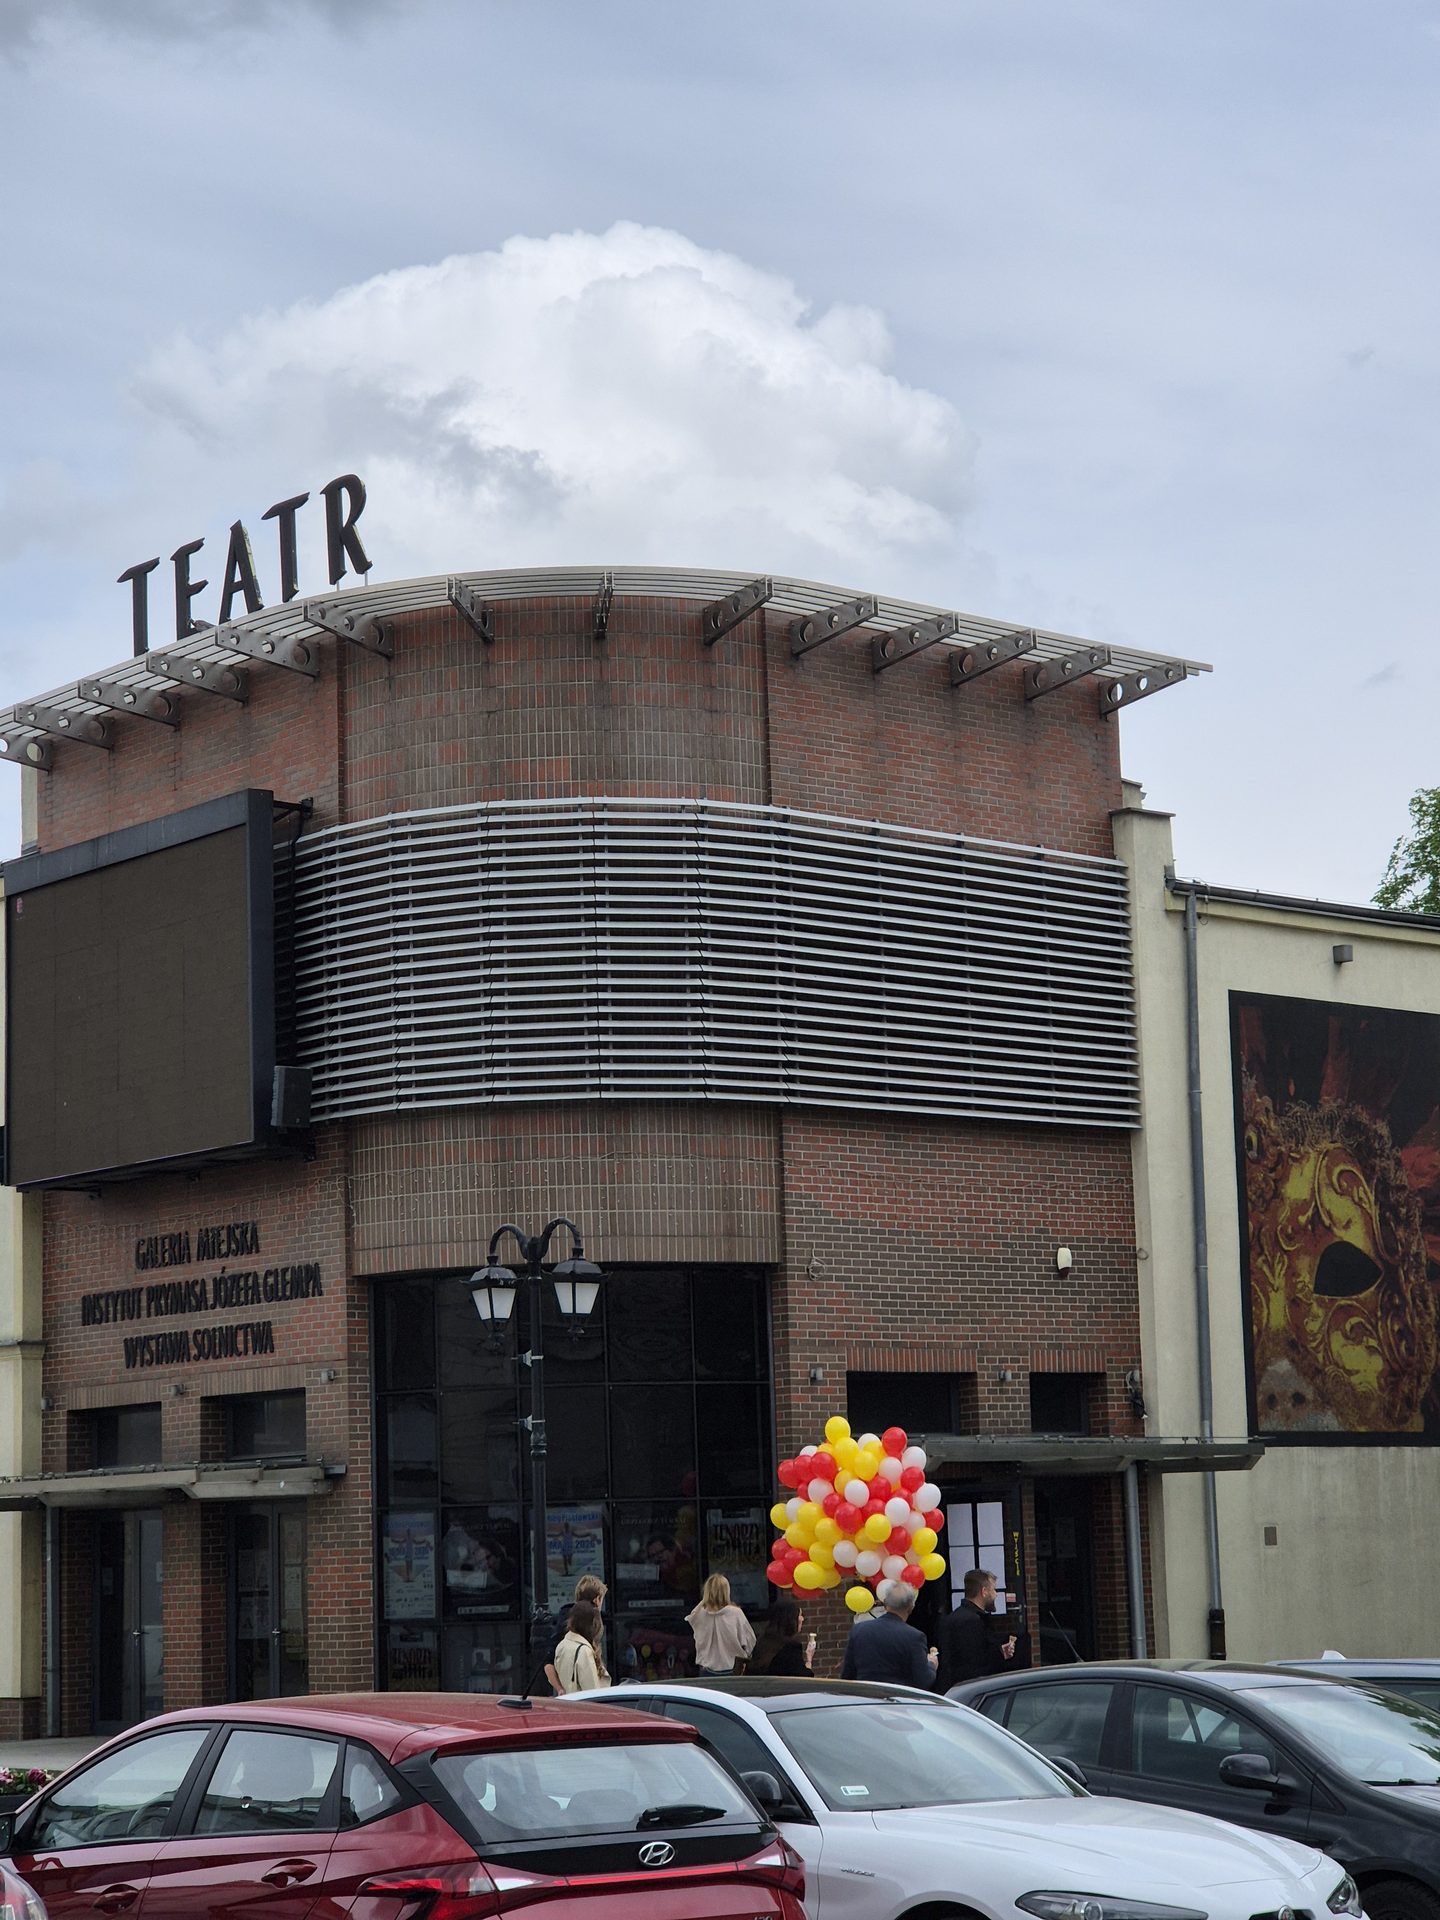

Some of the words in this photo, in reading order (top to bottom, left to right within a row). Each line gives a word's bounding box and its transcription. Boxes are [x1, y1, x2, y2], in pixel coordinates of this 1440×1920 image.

[117, 474, 373, 657] TEATR
[135, 1230, 192, 1270] GALERIA
[196, 1221, 260, 1261] MIEJSKA
[81, 1287, 143, 1326] INSTYTUT
[146, 1278, 209, 1318] PRYMASA
[209, 1266, 262, 1310] JÓZEFA
[262, 1262, 323, 1303] GLEMPA
[123, 1330, 191, 1369] WYSTAWA
[192, 1320, 274, 1362] SOLNICTWA
